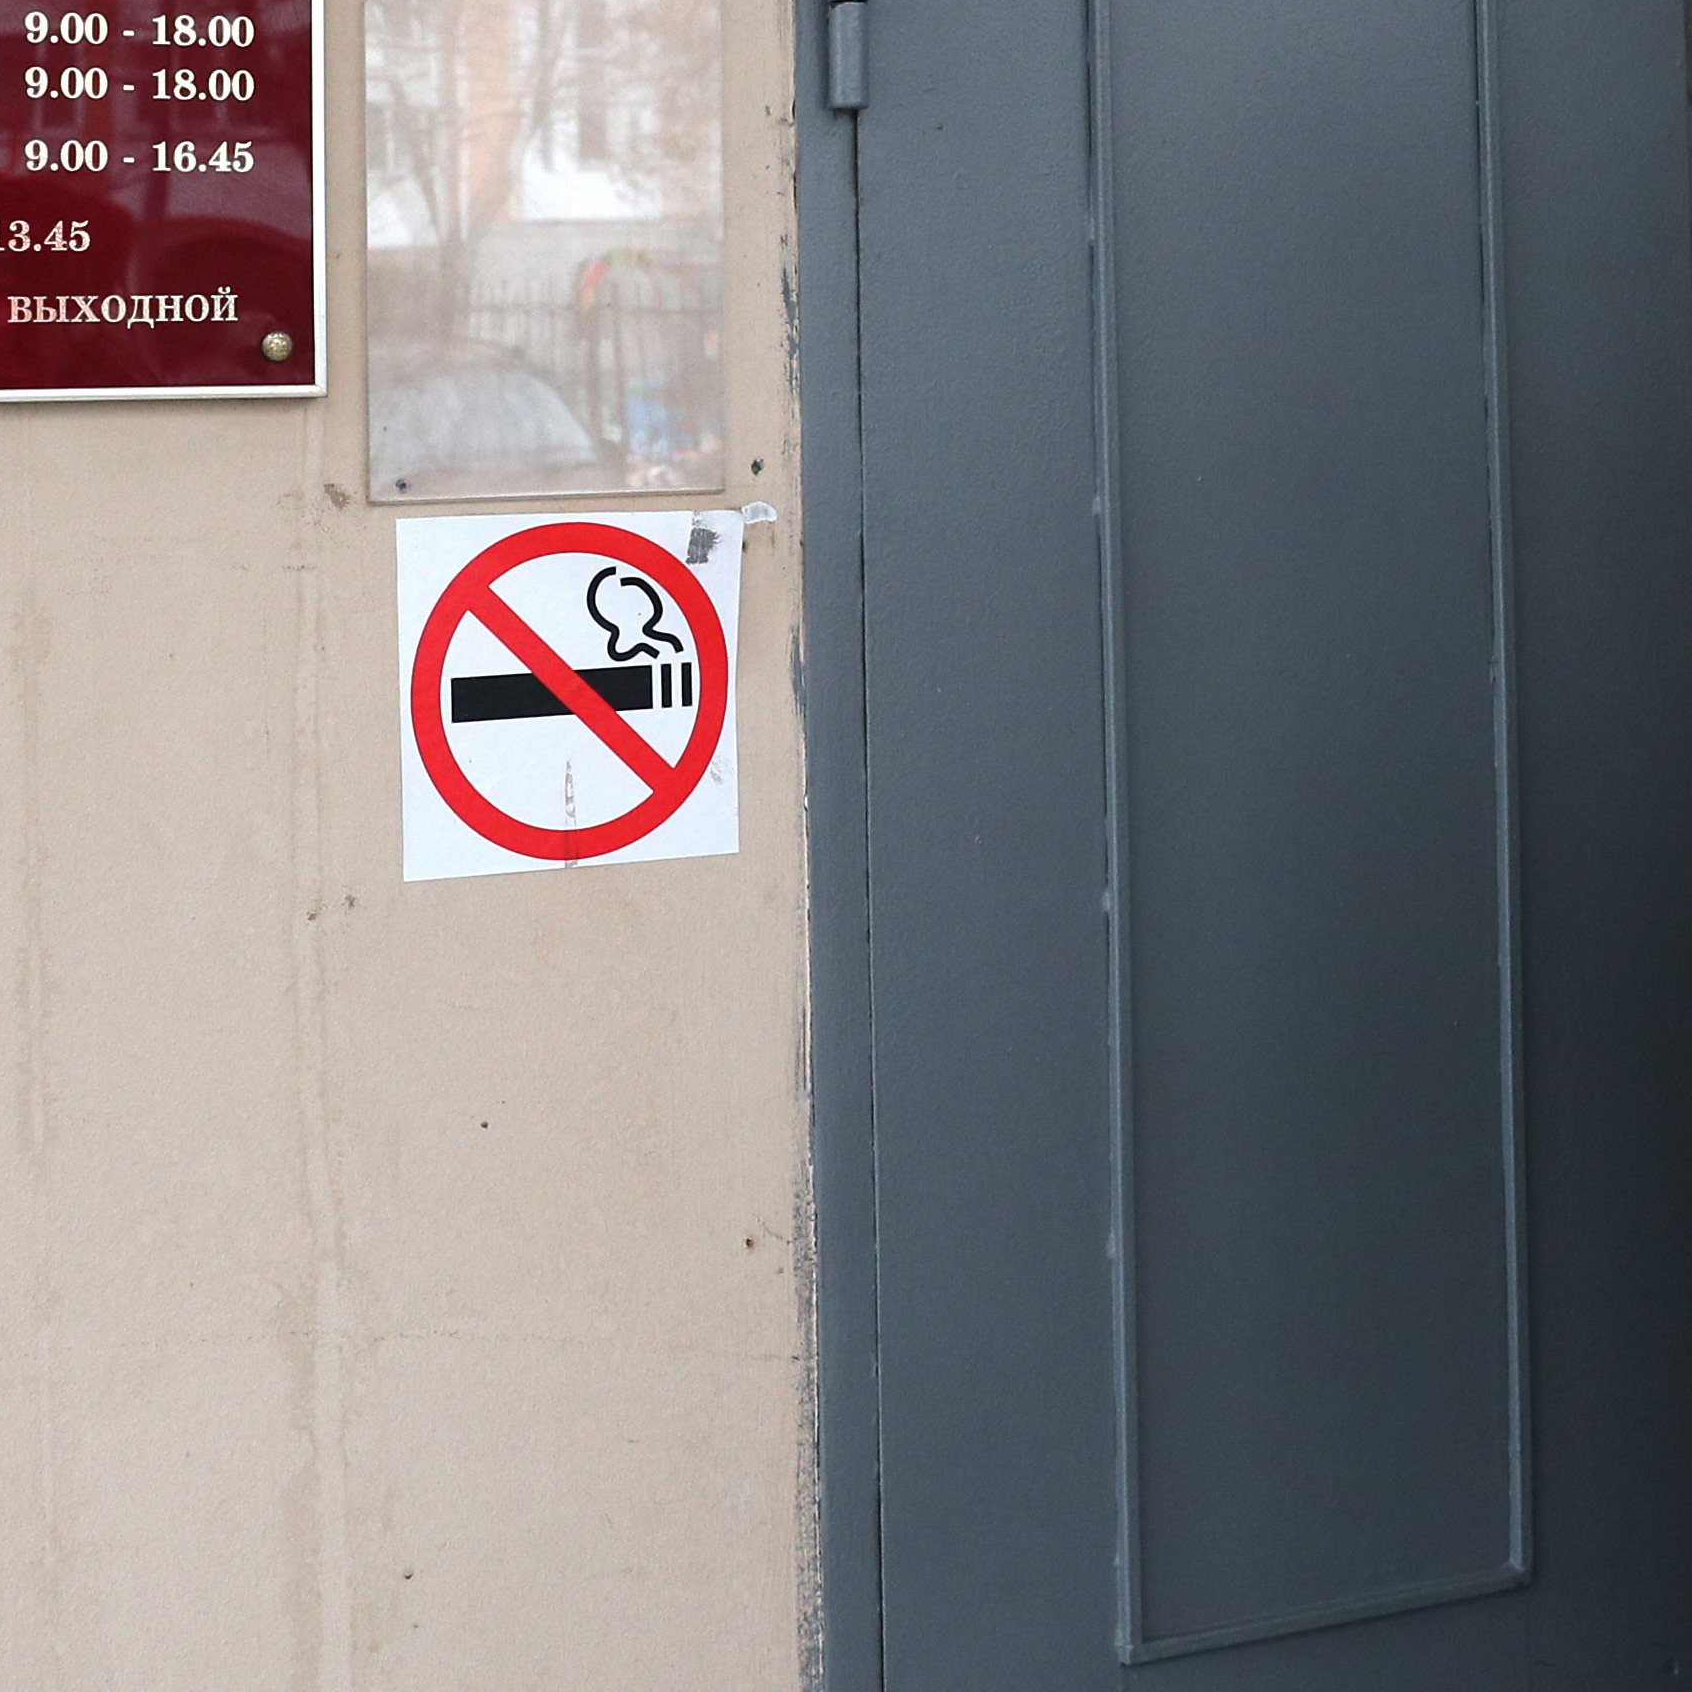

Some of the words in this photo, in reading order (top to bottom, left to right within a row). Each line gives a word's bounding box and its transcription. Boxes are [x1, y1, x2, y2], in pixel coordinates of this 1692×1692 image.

[24, 11, 108, 45] 9.00
[152, 14, 255, 48] 18.00
[24, 66, 108, 100] 9.00
[152, 68, 255, 101] 18.00
[24, 139, 109, 172] 9.00
[152, 140, 255, 173] 16.45
[7, 286, 239, 330] ВЫХОДНОЙ
